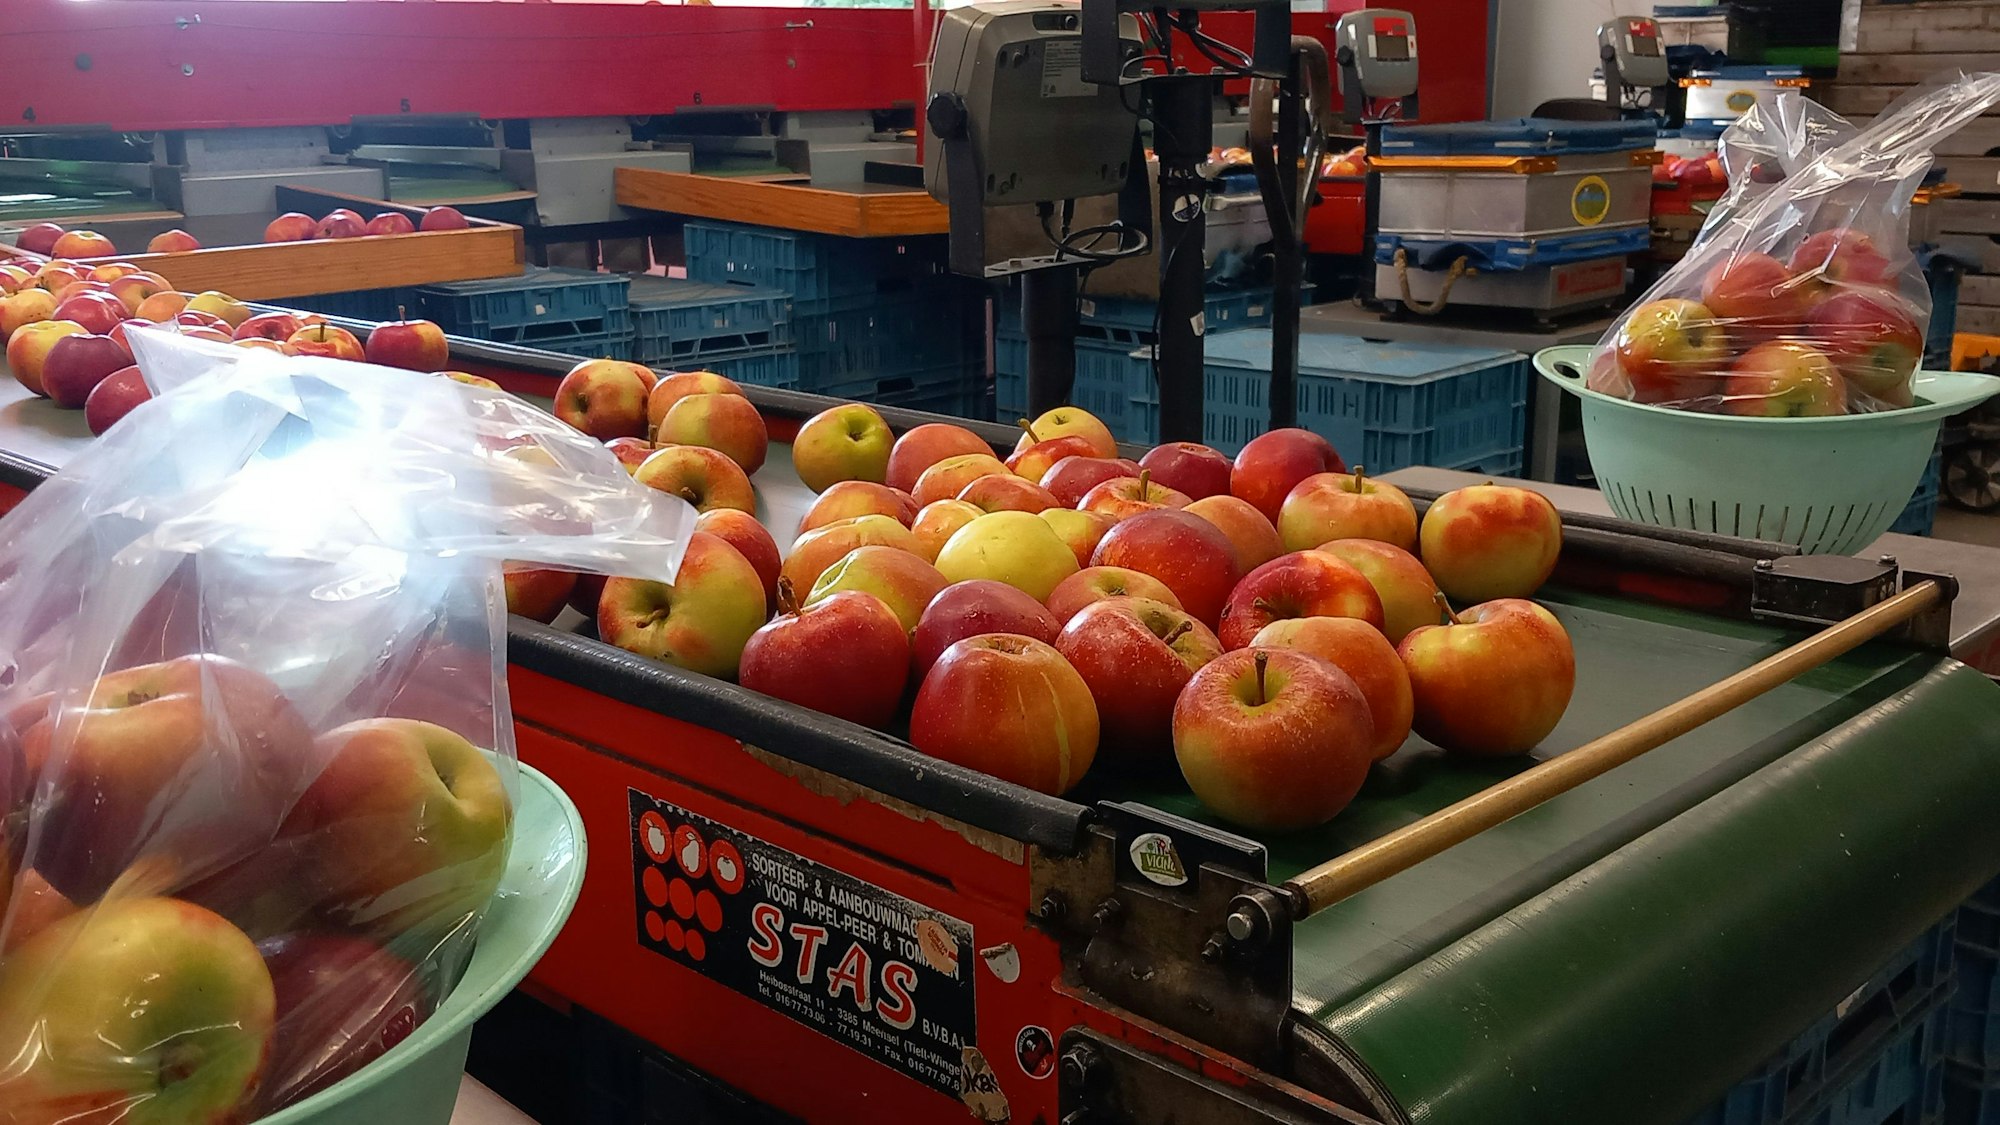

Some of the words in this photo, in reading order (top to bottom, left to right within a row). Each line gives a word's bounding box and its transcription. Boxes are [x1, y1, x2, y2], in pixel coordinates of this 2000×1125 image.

[22, 106, 35, 121] 4
[400, 99, 411, 112] 5
[693, 92, 702, 104] 6
[751, 852, 809, 891] SORTEER-
[814, 878, 824, 899] &
[764, 879, 798, 910] VOOR
[802, 896, 877, 944] APPEL-PEER
[882, 930, 892, 951] &
[897, 936, 960, 981] TOMN
[747, 902, 918, 1030] STAS
[757, 982, 772, 998] Tel.
[884, 1045, 904, 1064] Fax.
[815, 997, 825, 1010] 11
[862, 1018, 900, 1046] Meensel
[922, 1018, 962, 1051] B.V.B.A.
